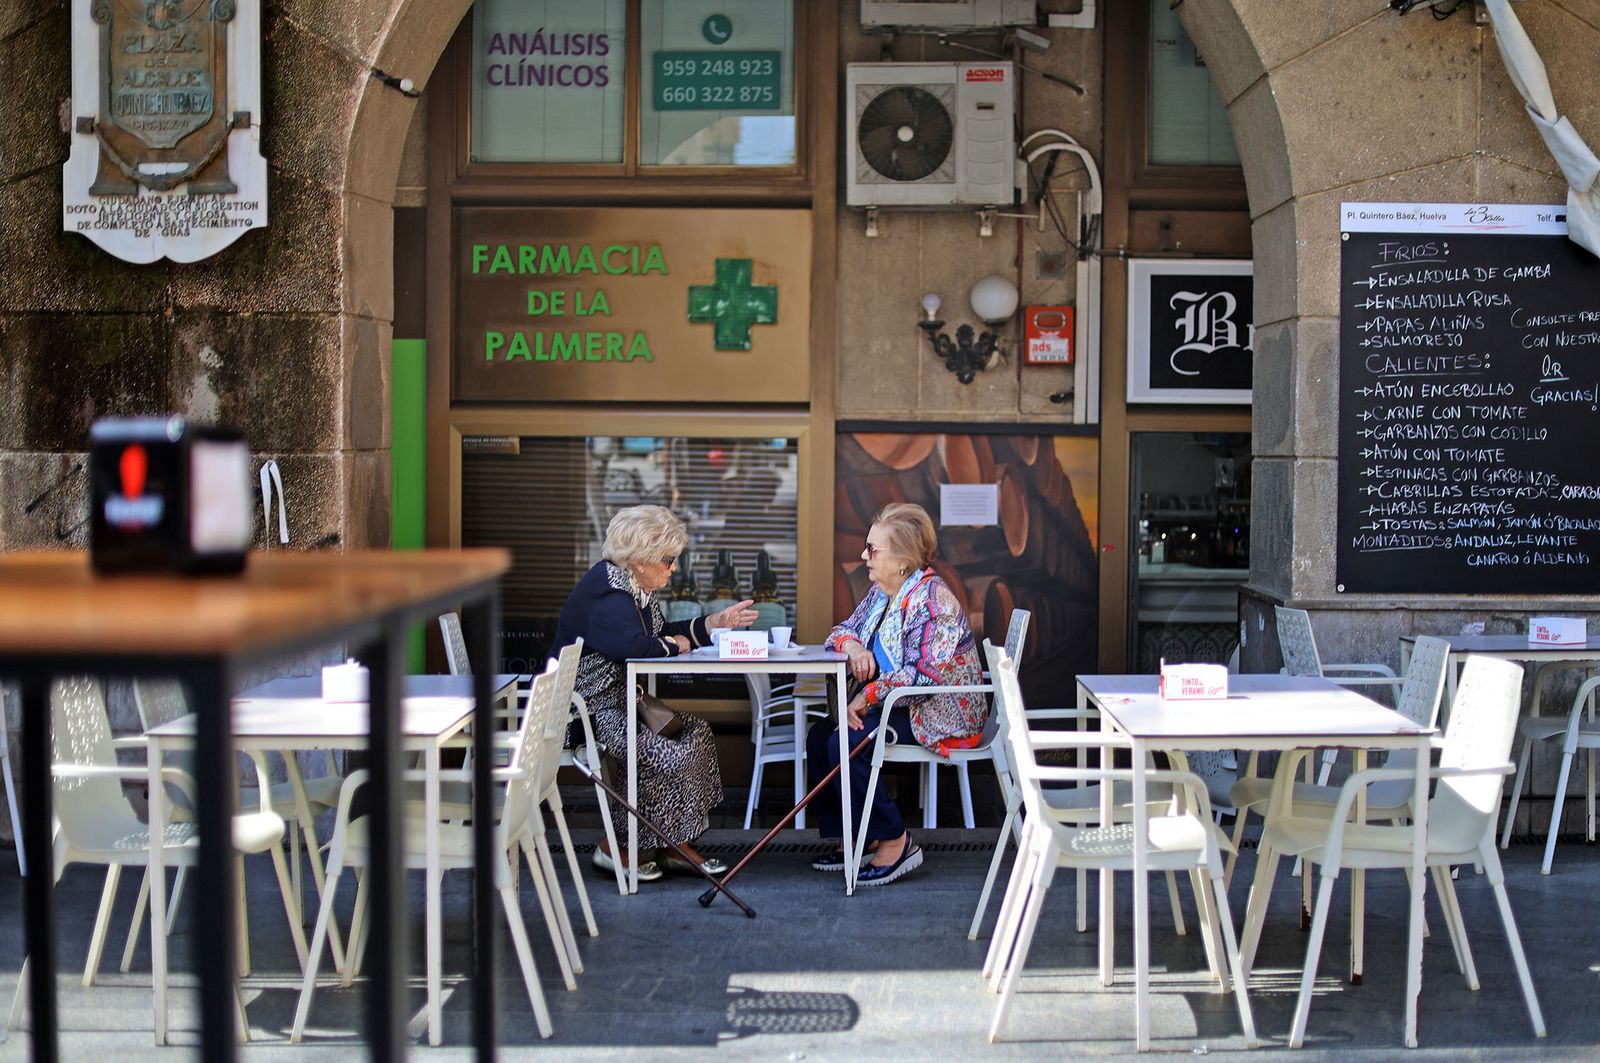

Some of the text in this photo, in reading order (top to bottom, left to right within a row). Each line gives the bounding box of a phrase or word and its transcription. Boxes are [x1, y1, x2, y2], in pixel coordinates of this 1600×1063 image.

[488, 28, 609, 56] ANÁLISIS
[487, 58, 609, 88] CLÍNICOS
[662, 60, 774, 76] 959 248 923
[662, 86, 774, 102] 660 322 875
[66, 205, 97, 214] DOTO
[125, 203, 168, 213] CIUDAD
[211, 202, 259, 211] GESTION
[100, 196, 162, 205] CIUDADANO
[184, 211, 228, 220] CELOSA
[1359, 211, 1395, 220] Quintero
[1419, 212, 1447, 220] Huelva
[1536, 213, 1554, 222] Telf.
[77, 219, 253, 230] DE COMPLETO ABASTECIMIENTO
[134, 229, 150, 238] DE
[472, 244, 668, 275] FARMACIA
[1378, 264, 1552, 288] ENSALADILLA DE GAMBA
[527, 290, 612, 316] DE LA
[1375, 290, 1512, 311] ENSALADILLA RUSA
[1373, 314, 1485, 334] PAPAS ALIÑAS
[1511, 308, 1575, 329] CONSULTE
[485, 331, 654, 363] PALMERA
[1371, 332, 1463, 348] SALMOREJO
[1522, 333, 1549, 349] CON
[1365, 353, 1491, 374] CALIENTES:
[1373, 381, 1515, 398] ATÚN ENCEBOLLAO
[1372, 405, 1528, 421] CARNE CON TOMATE
[1373, 424, 1548, 443] GARBANZOS CON CODILLO
[1373, 443, 1506, 463] ATÚN CON TOMATE
[1374, 466, 1561, 487] ESPINACAS CON GARBANZOS
[1378, 482, 1463, 499] CABRILLAS
[1379, 500, 1428, 515] HABAS
[1517, 534, 1578, 547] LEVANTE
[1467, 551, 1519, 566] CANARIO
[1181, 687, 1205, 696] VERANO
